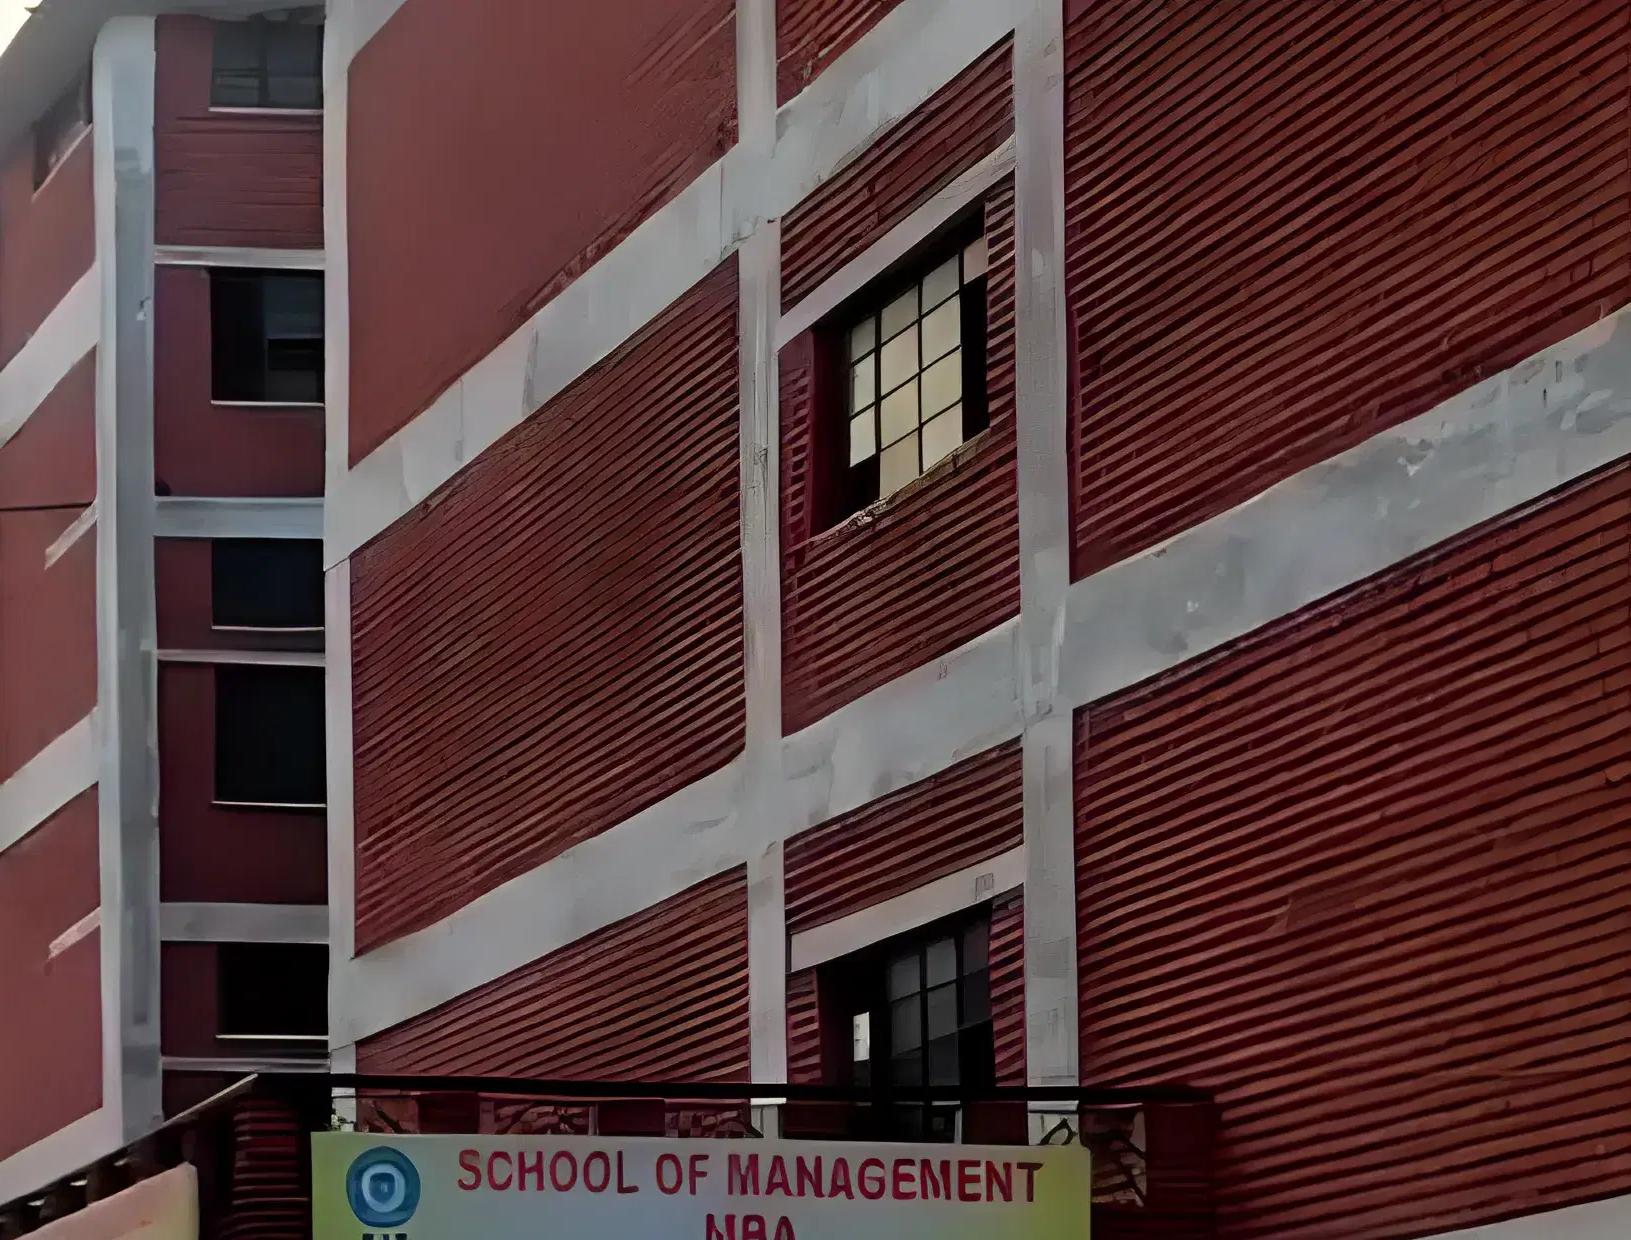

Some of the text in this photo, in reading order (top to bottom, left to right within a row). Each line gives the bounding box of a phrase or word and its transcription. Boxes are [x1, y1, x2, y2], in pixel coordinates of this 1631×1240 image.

[457, 1149, 1043, 1204] SCHOOL OF MANAGEMENT
